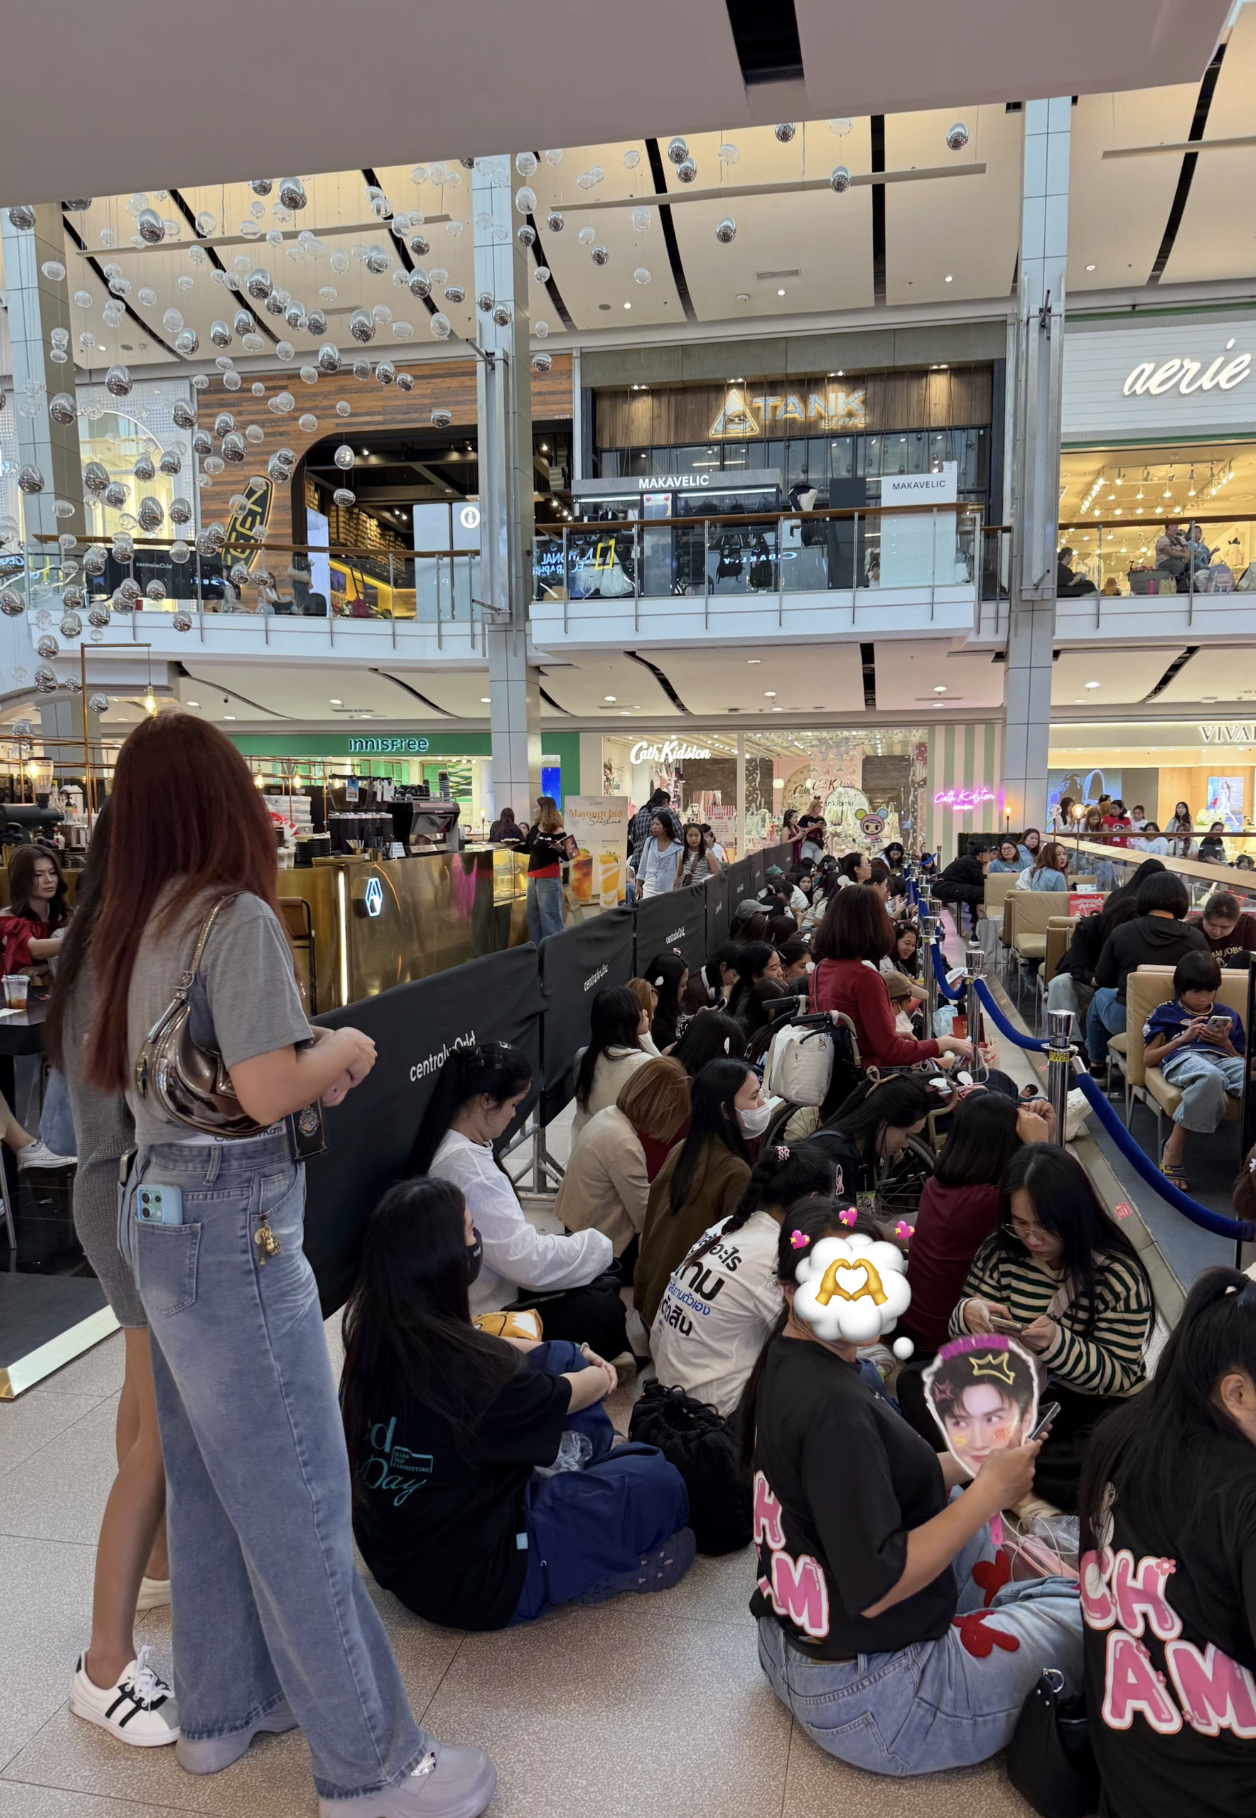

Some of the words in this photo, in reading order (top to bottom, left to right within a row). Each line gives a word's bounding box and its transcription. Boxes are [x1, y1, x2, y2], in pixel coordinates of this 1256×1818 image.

[1123, 338, 1252, 396] aerie
[752, 391, 868, 421] TANK
[822, 415, 869, 429] store
[638, 475, 709, 489] MAKAVELIC
[892, 480, 946, 490] MAKAVELIC
[630, 741, 660, 764] Cath
[659, 740, 711, 763] Kidston
[934, 790, 957, 803] Cath
[957, 787, 996, 804] Kidston
[1079, 1545, 1184, 1641] CH
